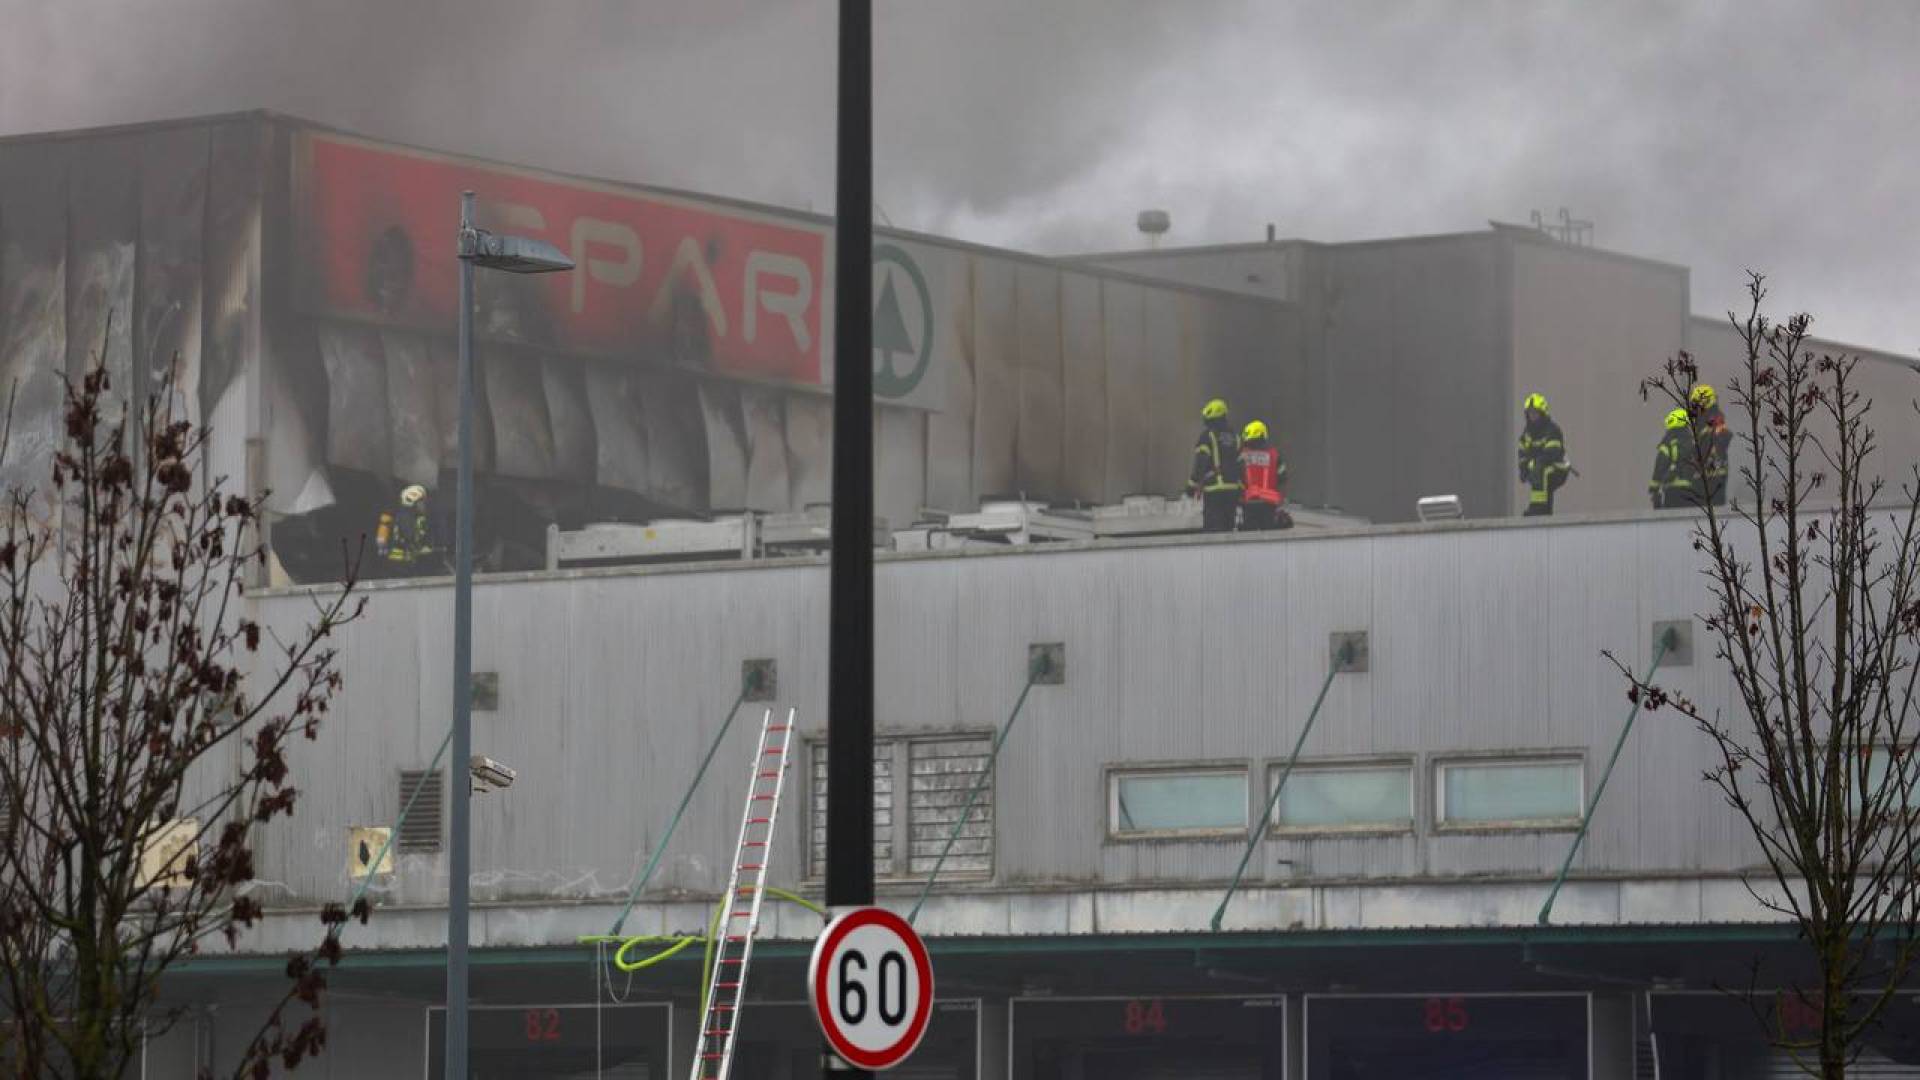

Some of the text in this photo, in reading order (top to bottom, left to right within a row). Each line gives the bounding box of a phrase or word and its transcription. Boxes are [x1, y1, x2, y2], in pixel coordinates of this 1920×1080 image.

[482, 202, 811, 353] PAR
[839, 949, 907, 1026] 60
[526, 1008, 561, 1040] 82
[1125, 1000, 1167, 1033] 84
[1424, 997, 1468, 1032] 85
